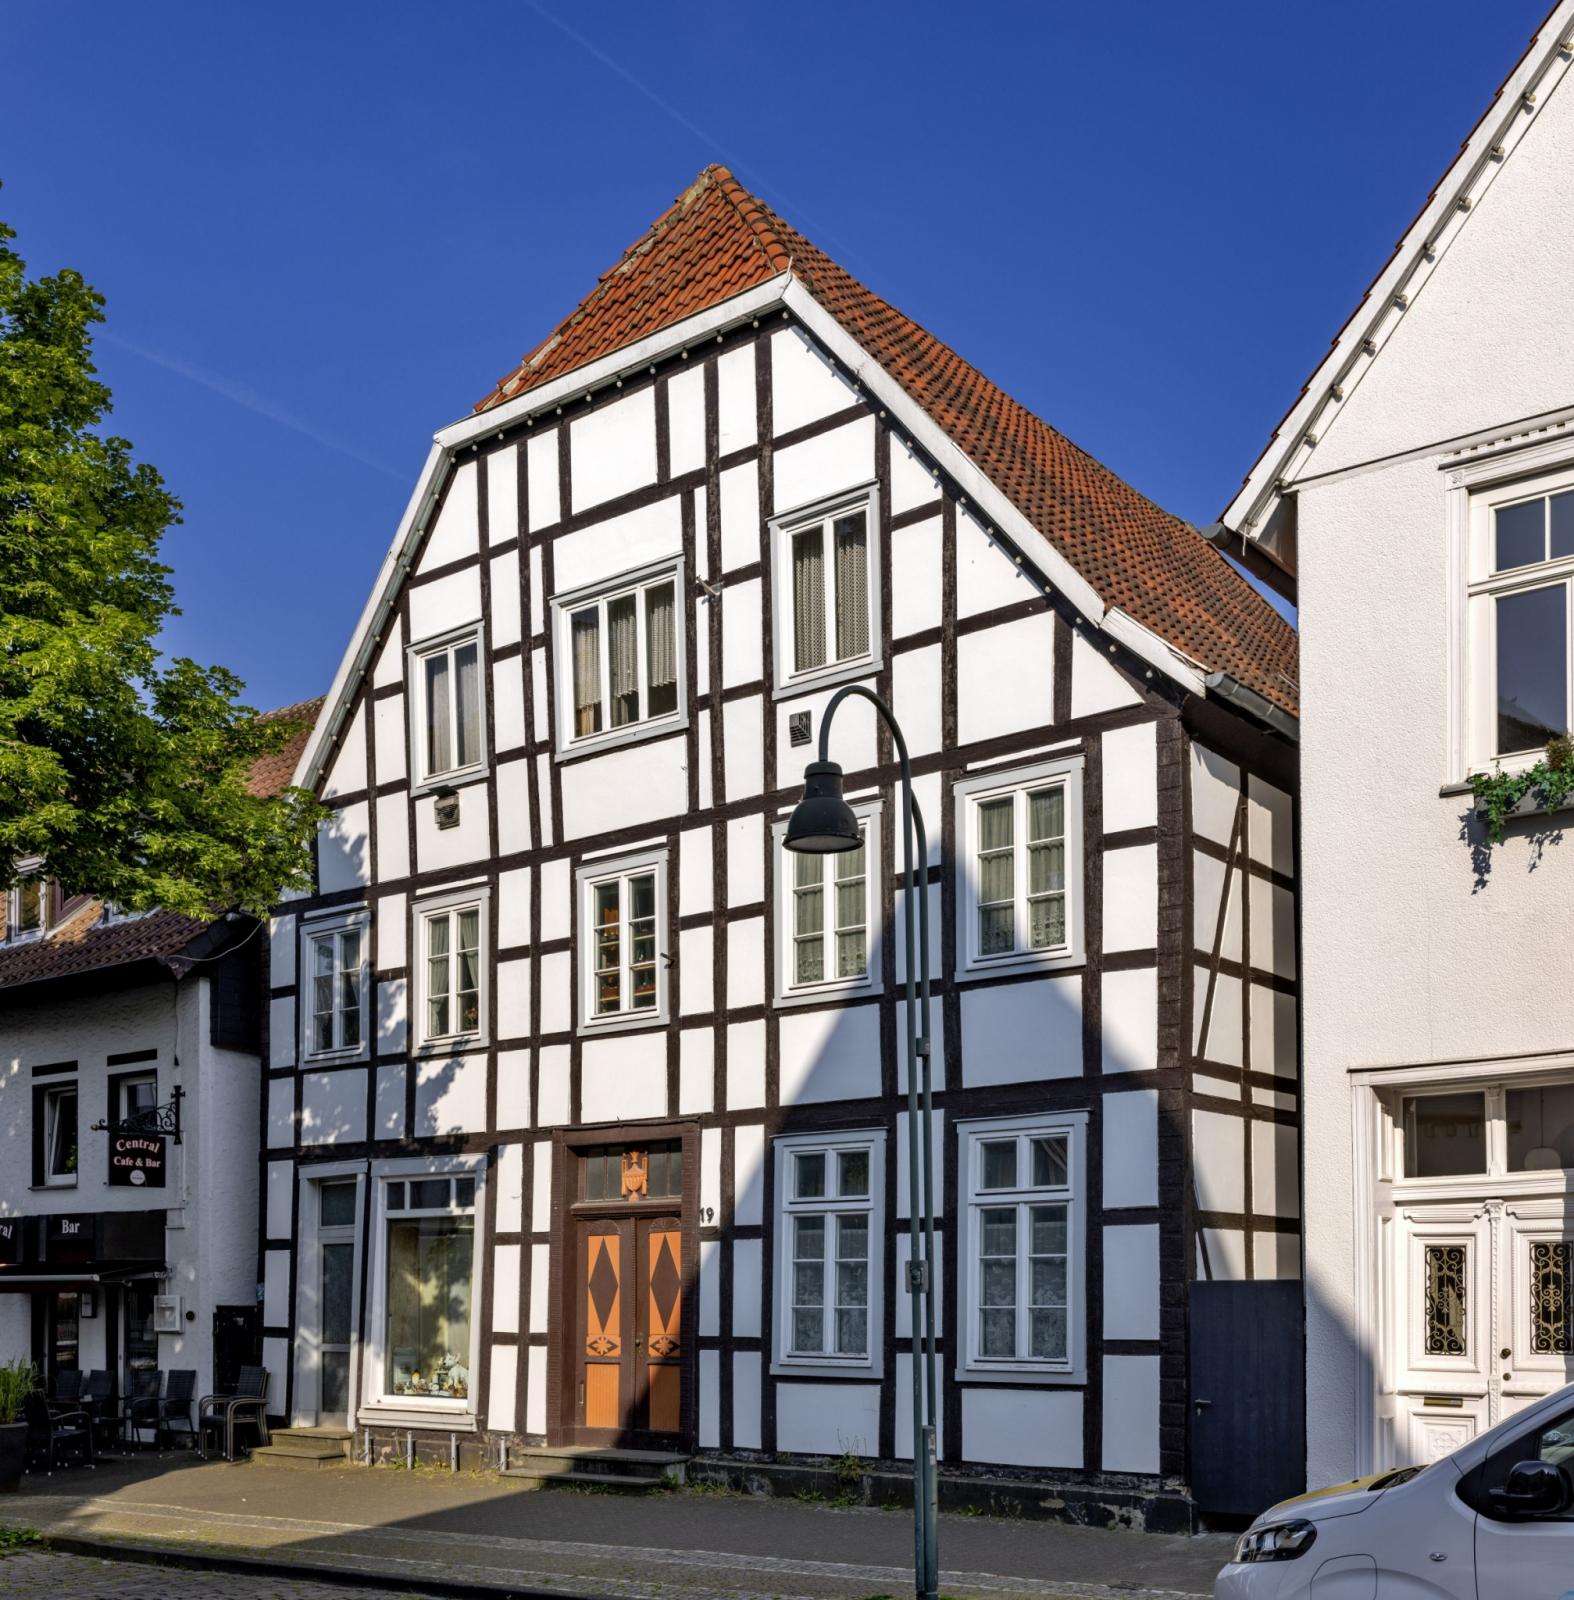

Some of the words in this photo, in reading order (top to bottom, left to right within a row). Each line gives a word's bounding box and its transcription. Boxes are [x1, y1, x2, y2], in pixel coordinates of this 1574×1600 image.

[116, 1139, 160, 1153] Central
[135, 1157, 144, 1167] &
[145, 1158, 161, 1168] Bar
[699, 1206, 715, 1224] 19
[61, 1219, 80, 1234] Bar
